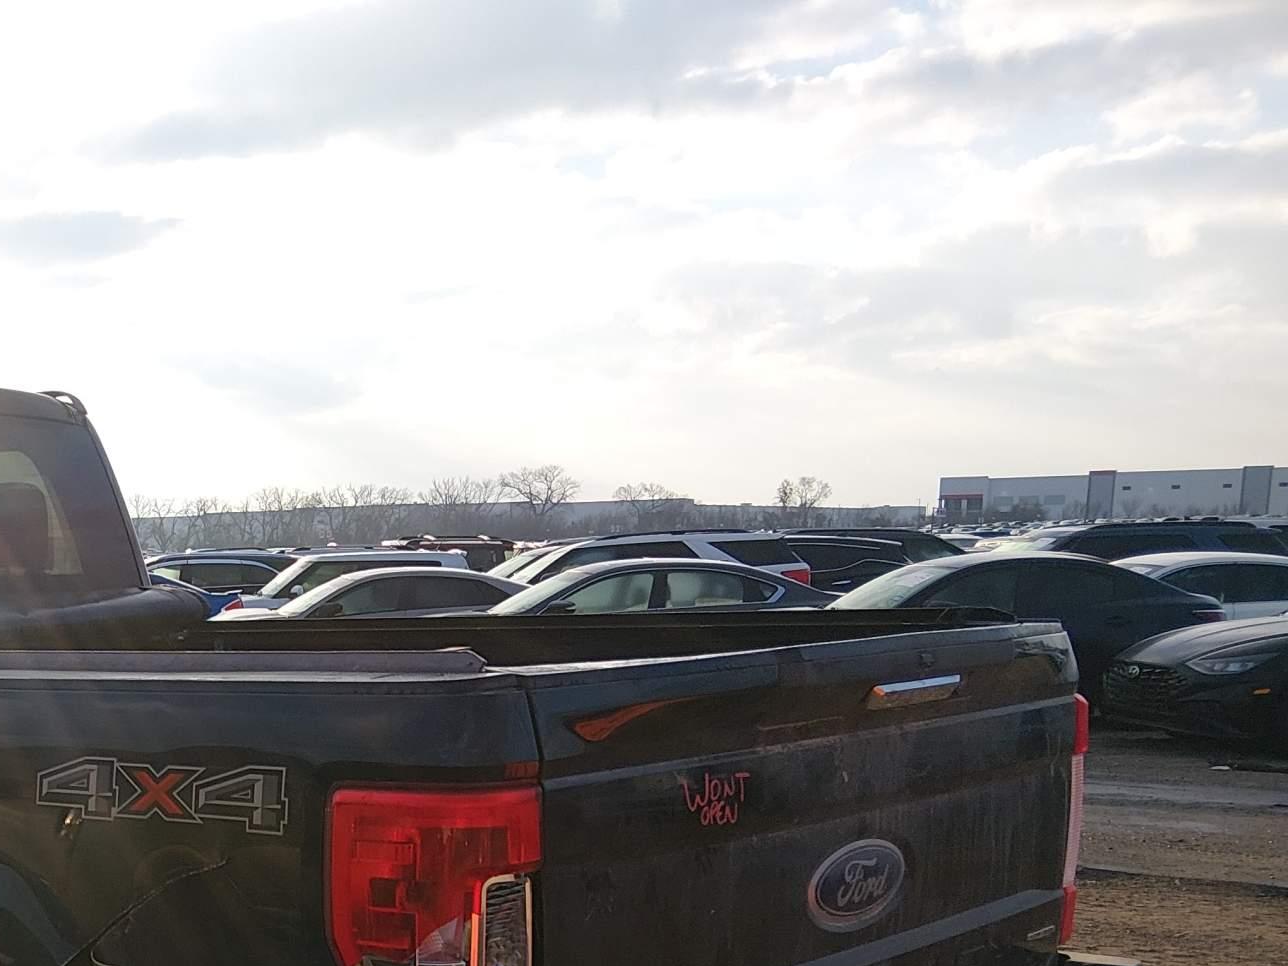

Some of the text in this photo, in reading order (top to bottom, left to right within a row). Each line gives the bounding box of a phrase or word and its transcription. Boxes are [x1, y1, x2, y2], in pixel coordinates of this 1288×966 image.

[36, 756, 289, 835] 4X4
[680, 771, 750, 812] WONT
[700, 800, 739, 826] OPEN
[837, 858, 889, 907] Ford
